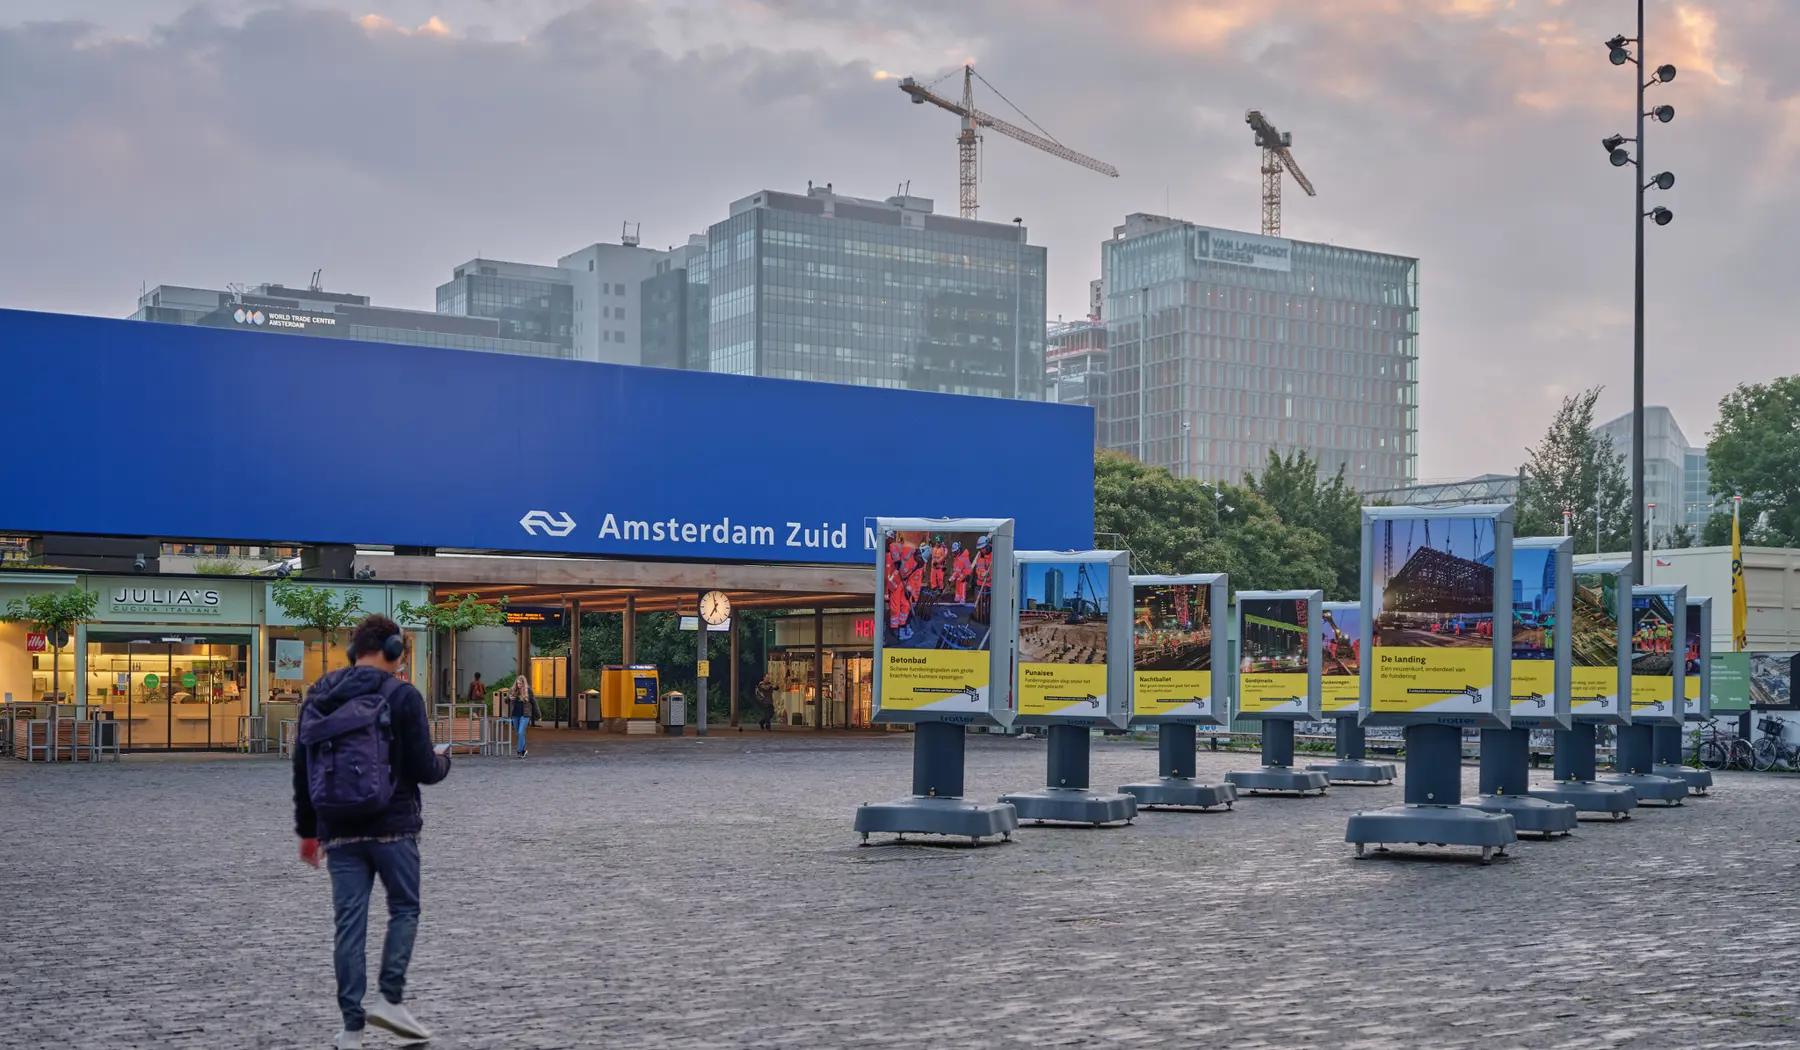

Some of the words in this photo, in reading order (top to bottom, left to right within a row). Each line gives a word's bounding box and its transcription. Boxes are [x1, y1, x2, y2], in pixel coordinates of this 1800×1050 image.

[1212, 238, 1233, 250] VAN
[1237, 240, 1288, 258] LANSCHOT
[1212, 249, 1254, 264] KEMPEN
[269, 320, 304, 328] AMSTERDAM
[312, 317, 336, 325] CENTER
[598, 513, 774, 546] Amsterdam
[786, 522, 847, 548] Zuid
[114, 589, 218, 605] JULIA'S
[28, 636, 44, 649] illy
[1395, 656, 1426, 665] landing
